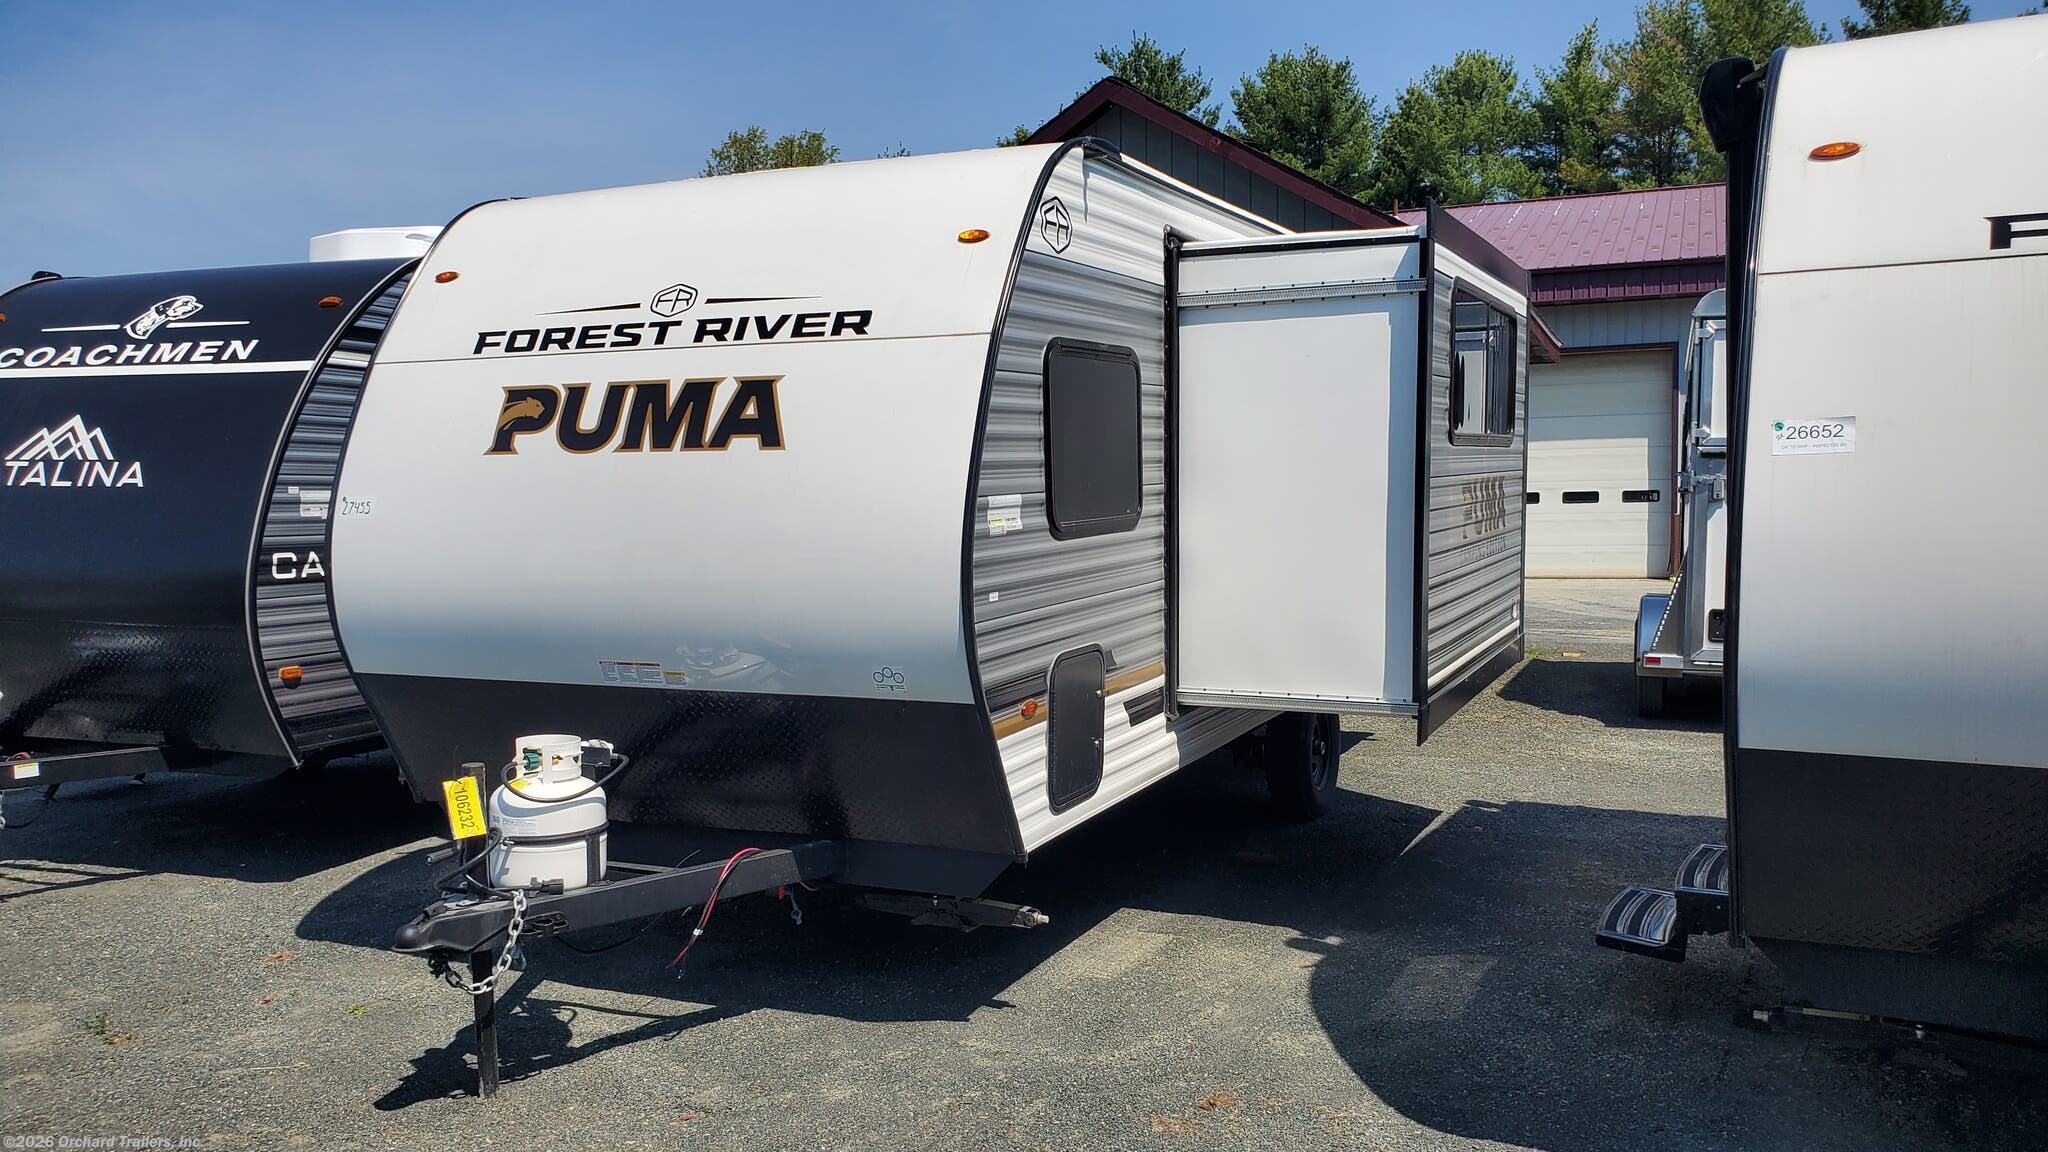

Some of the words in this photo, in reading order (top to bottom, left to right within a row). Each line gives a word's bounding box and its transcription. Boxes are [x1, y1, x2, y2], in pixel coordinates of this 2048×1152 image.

[473, 320, 682, 354] FOREST
[694, 309, 873, 343] RIVER
[0, 339, 259, 368] COACHMEN
[483, 374, 786, 455] PUMA
[1786, 423, 1844, 440] 26652
[5, 461, 144, 488] TALINA
[342, 500, 372, 516] 27455
[271, 551, 325, 580] CA
[454, 788, 476, 830] 106232
